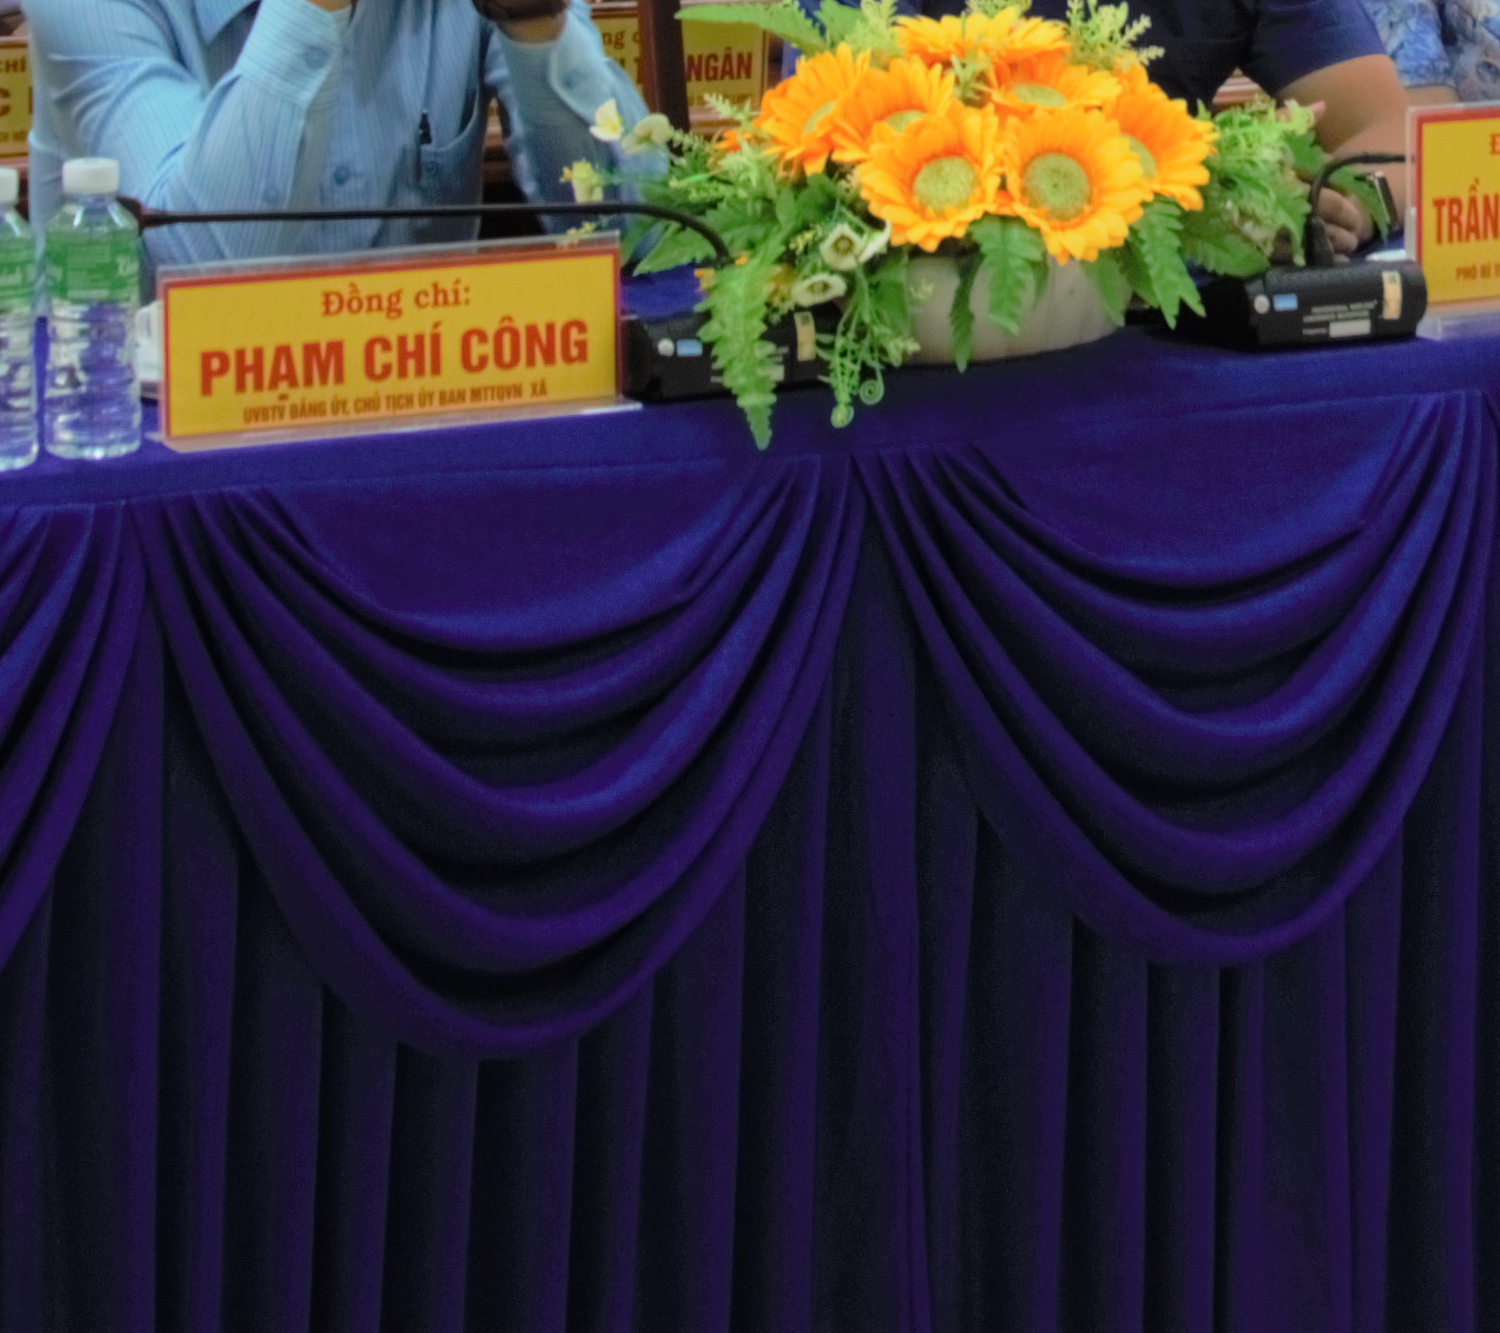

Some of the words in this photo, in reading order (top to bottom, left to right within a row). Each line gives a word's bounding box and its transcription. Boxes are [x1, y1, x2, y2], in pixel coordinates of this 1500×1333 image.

[686, 46, 753, 82] NGÂN
[1432, 176, 1500, 245] TRẦN
[321, 282, 403, 319] Đồng
[415, 278, 471, 310] chí:
[200, 339, 345, 401] PHẠM
[363, 321, 442, 382] CHÍ
[460, 315, 589, 374] CÔNG
[439, 385, 467, 407] BAN
